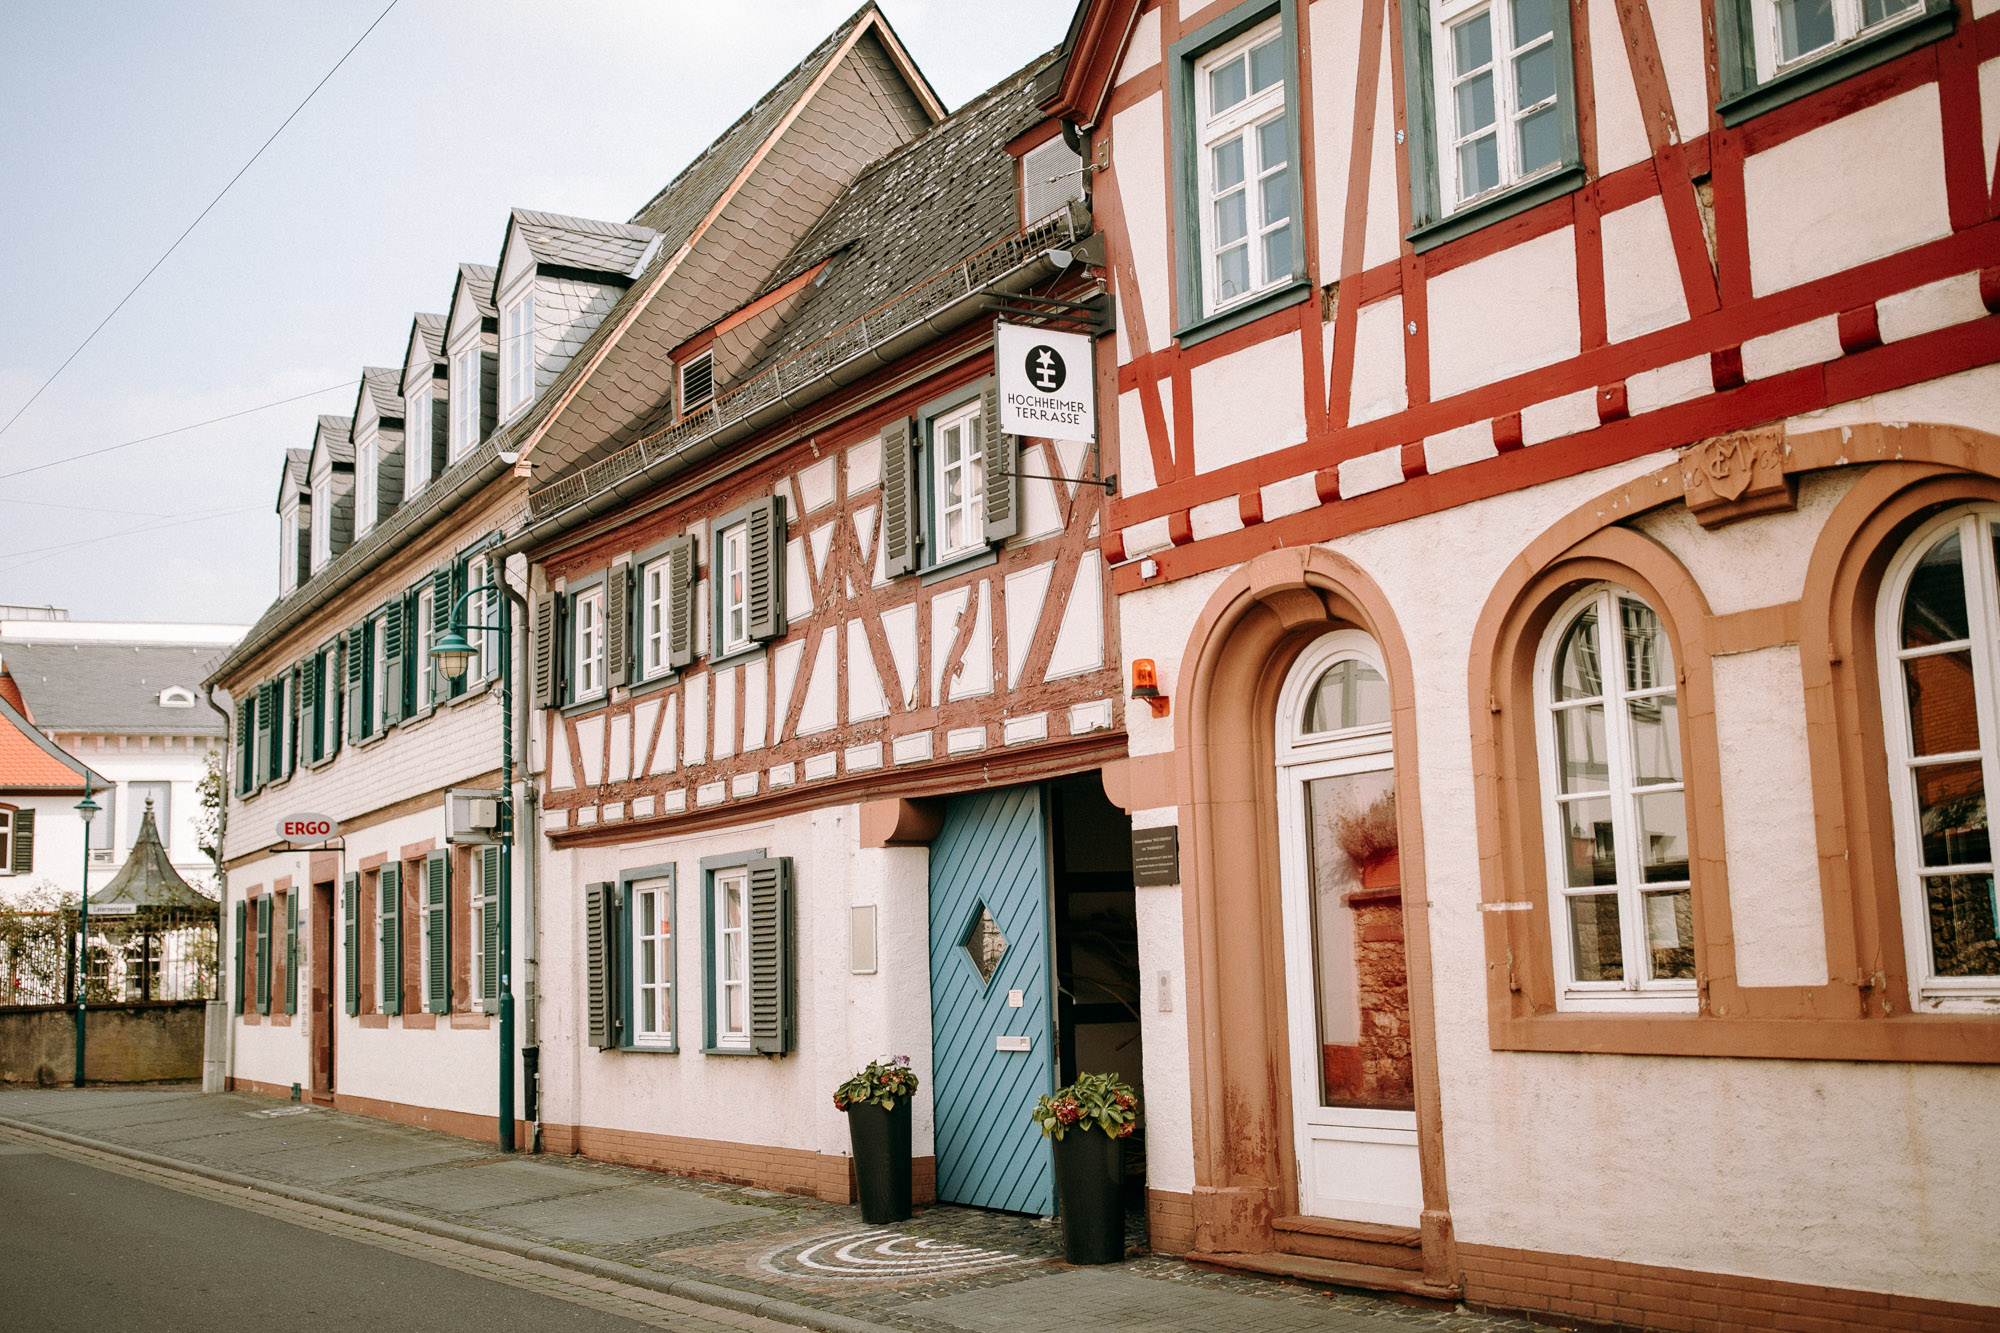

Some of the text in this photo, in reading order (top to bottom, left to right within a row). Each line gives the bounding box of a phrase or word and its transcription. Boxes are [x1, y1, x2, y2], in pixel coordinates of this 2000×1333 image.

[1007, 393, 1087, 414] HOCHHEIMER
[1015, 406, 1080, 425] TERRASSE
[284, 821, 330, 835] ERGO
